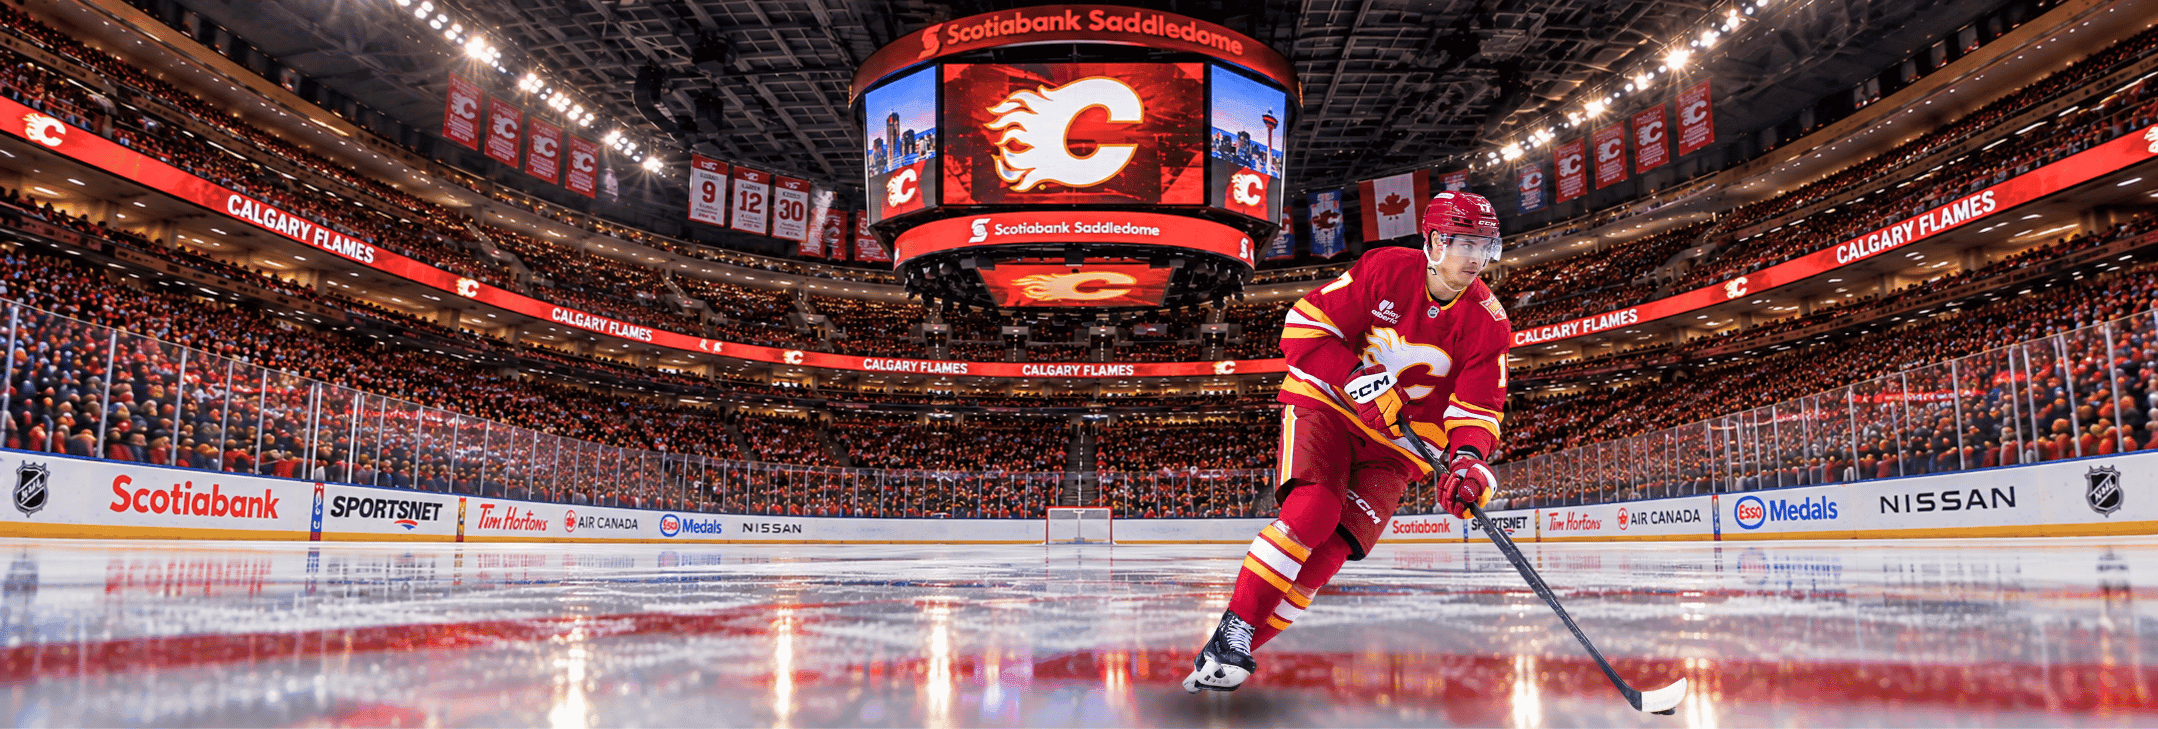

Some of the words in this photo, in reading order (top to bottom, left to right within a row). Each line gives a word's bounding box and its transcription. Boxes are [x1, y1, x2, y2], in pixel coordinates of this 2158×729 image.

[947, 9, 1081, 45] Scotiabank
[1088, 10, 1243, 55] Saddledome
[702, 180, 716, 204] 9
[739, 190, 762, 214] 12
[778, 198, 804, 222] 30
[227, 194, 312, 241] CALGARY
[313, 227, 375, 264] FLAMES
[994, 222, 1070, 236] Scotiabank
[1074, 222, 1160, 237] Saddledome
[1836, 220, 1914, 264] CALGARY
[1919, 190, 1996, 236] FLAMES
[552, 307, 607, 332] CALGARY
[608, 321, 653, 342] FLAMES
[1371, 309, 1398, 325] alberta
[1383, 309, 1401, 320] play
[1514, 321, 1580, 346] CALGARY
[1582, 308, 1638, 333] FLAMES
[863, 358, 918, 373] CALGARY
[919, 361, 968, 375] FLAMES
[1022, 364, 1082, 376] CALGARY
[1083, 364, 1134, 377] FLAMES
[1349, 374, 1390, 400] CCM
[109, 474, 280, 519] Scotiabank
[330, 495, 443, 521] SPORTSNET
[1346, 489, 1381, 525] CCM
[1738, 504, 1762, 521] Esso
[1769, 495, 1838, 521] Medals
[1880, 485, 2016, 514] NISSAN
[477, 503, 501, 530] Tim
[502, 506, 548, 531] Hortons
[578, 516, 595, 529] AIR
[597, 516, 638, 530] CANADA
[682, 519, 722, 534] Medals
[742, 522, 802, 534] NISSAN
[1392, 518, 1450, 534] Scotiabank
[1471, 516, 1528, 531] SPRTSNET
[1549, 512, 1566, 531] Tim
[1566, 512, 1602, 531] Hortons
[1630, 511, 1648, 525] AIR
[1650, 508, 1702, 525] CANADA
